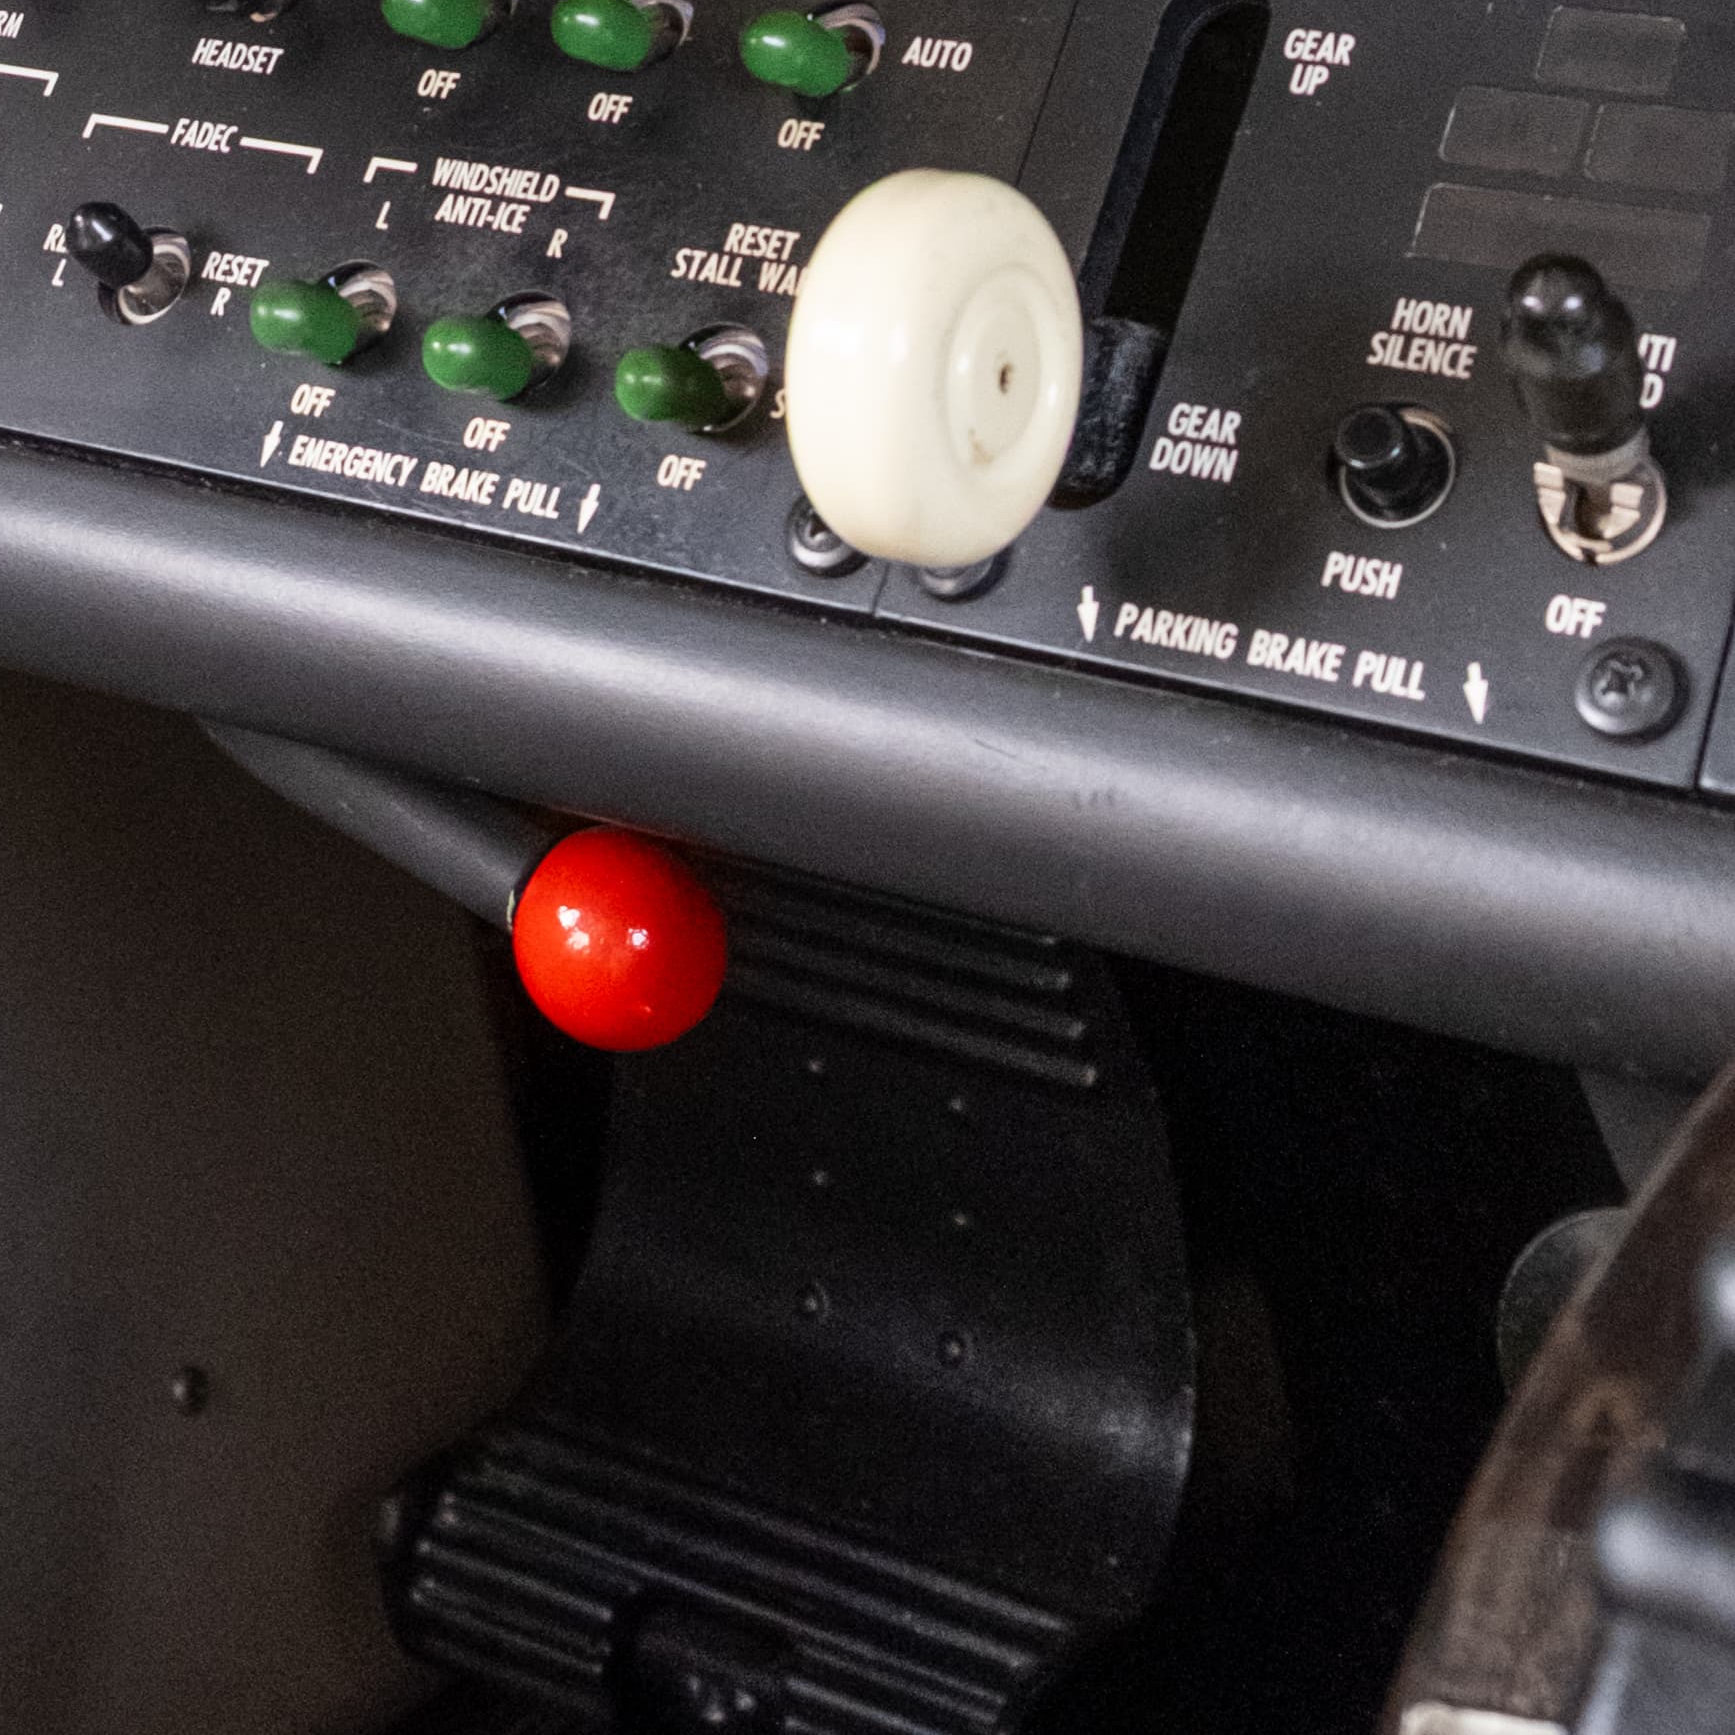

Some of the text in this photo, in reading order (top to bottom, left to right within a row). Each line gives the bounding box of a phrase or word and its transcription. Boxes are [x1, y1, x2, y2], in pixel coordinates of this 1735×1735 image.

[902, 37, 973, 72] AUTO
[1284, 29, 1355, 66] GEAR
[192, 38, 461, 100] HEADSET OFF
[171, 117, 238, 153] FADEC
[432, 157, 560, 202] WINDSHIELD
[724, 223, 800, 261] RESET
[202, 251, 269, 287] RESET
[671, 248, 742, 288] STALL
[1391, 298, 1472, 339] HORN
[1367, 332, 1477, 379] SILENCE
[1168, 402, 1242, 445] GEAR
[288, 435, 499, 507] EMERGENCY BRAKE
[503, 478, 560, 518] PULL
[1321, 551, 1404, 599] PUSH
[1114, 602, 1426, 700] PARKING BRAKE PULL
